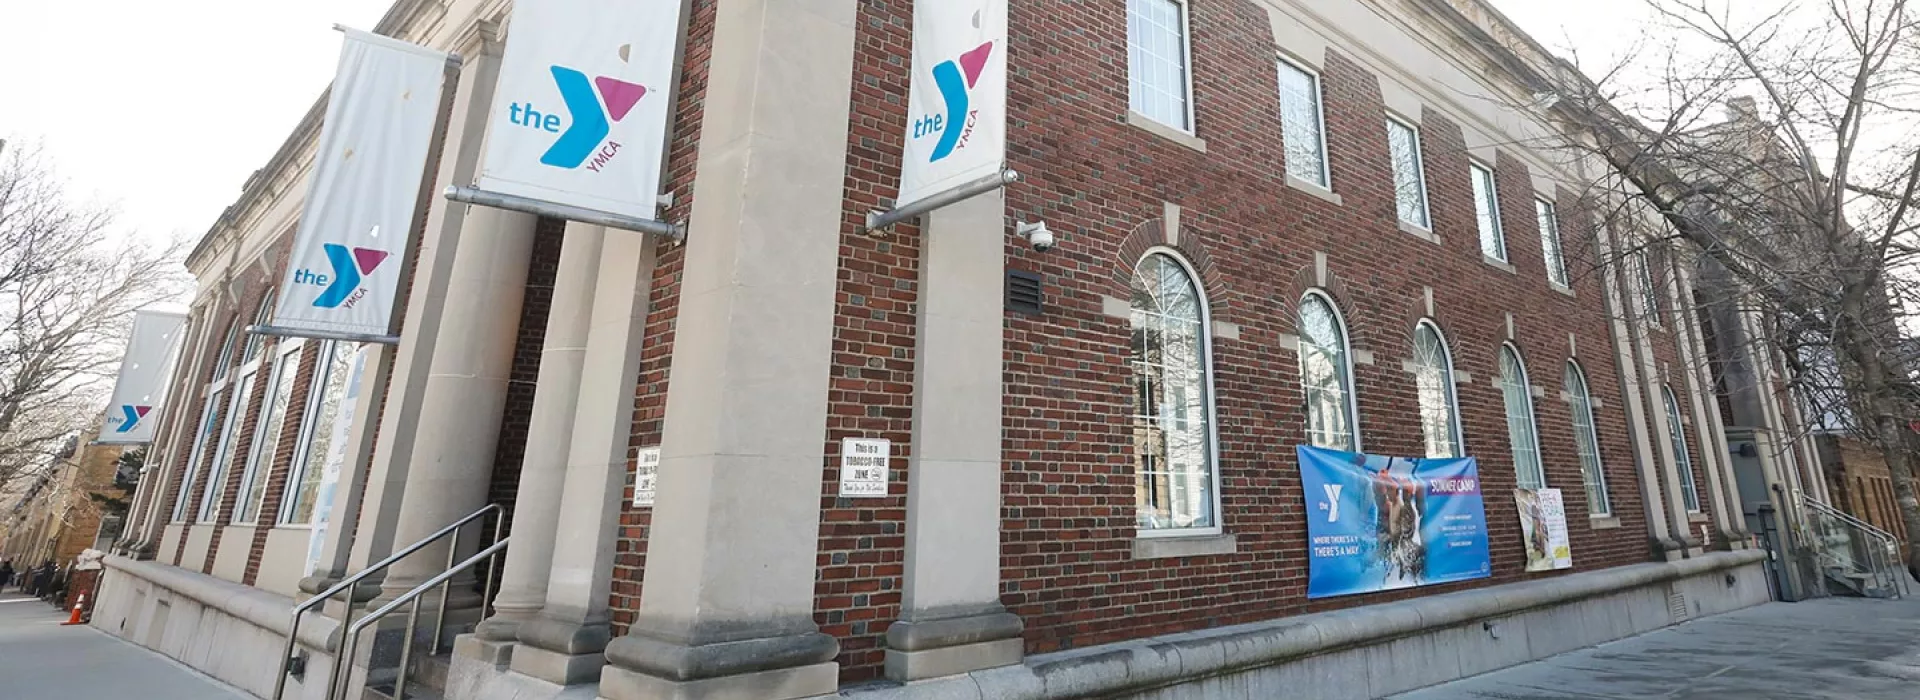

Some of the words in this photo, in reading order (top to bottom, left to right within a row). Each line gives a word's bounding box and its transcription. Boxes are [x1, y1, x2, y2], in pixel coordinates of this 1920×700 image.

[509, 102, 561, 133] the
[913, 113, 943, 139] the
[956, 109, 979, 150] YMCA
[586, 140, 622, 173] YMCA
[294, 268, 328, 287] the
[343, 287, 368, 309] YMCA
[1430, 479, 1457, 493] SUMMER
[1457, 478, 1475, 492] CAMP
[1314, 546, 1340, 557] THERE'S
[1340, 546, 1345, 556] A
[1345, 545, 1359, 555] WAY
